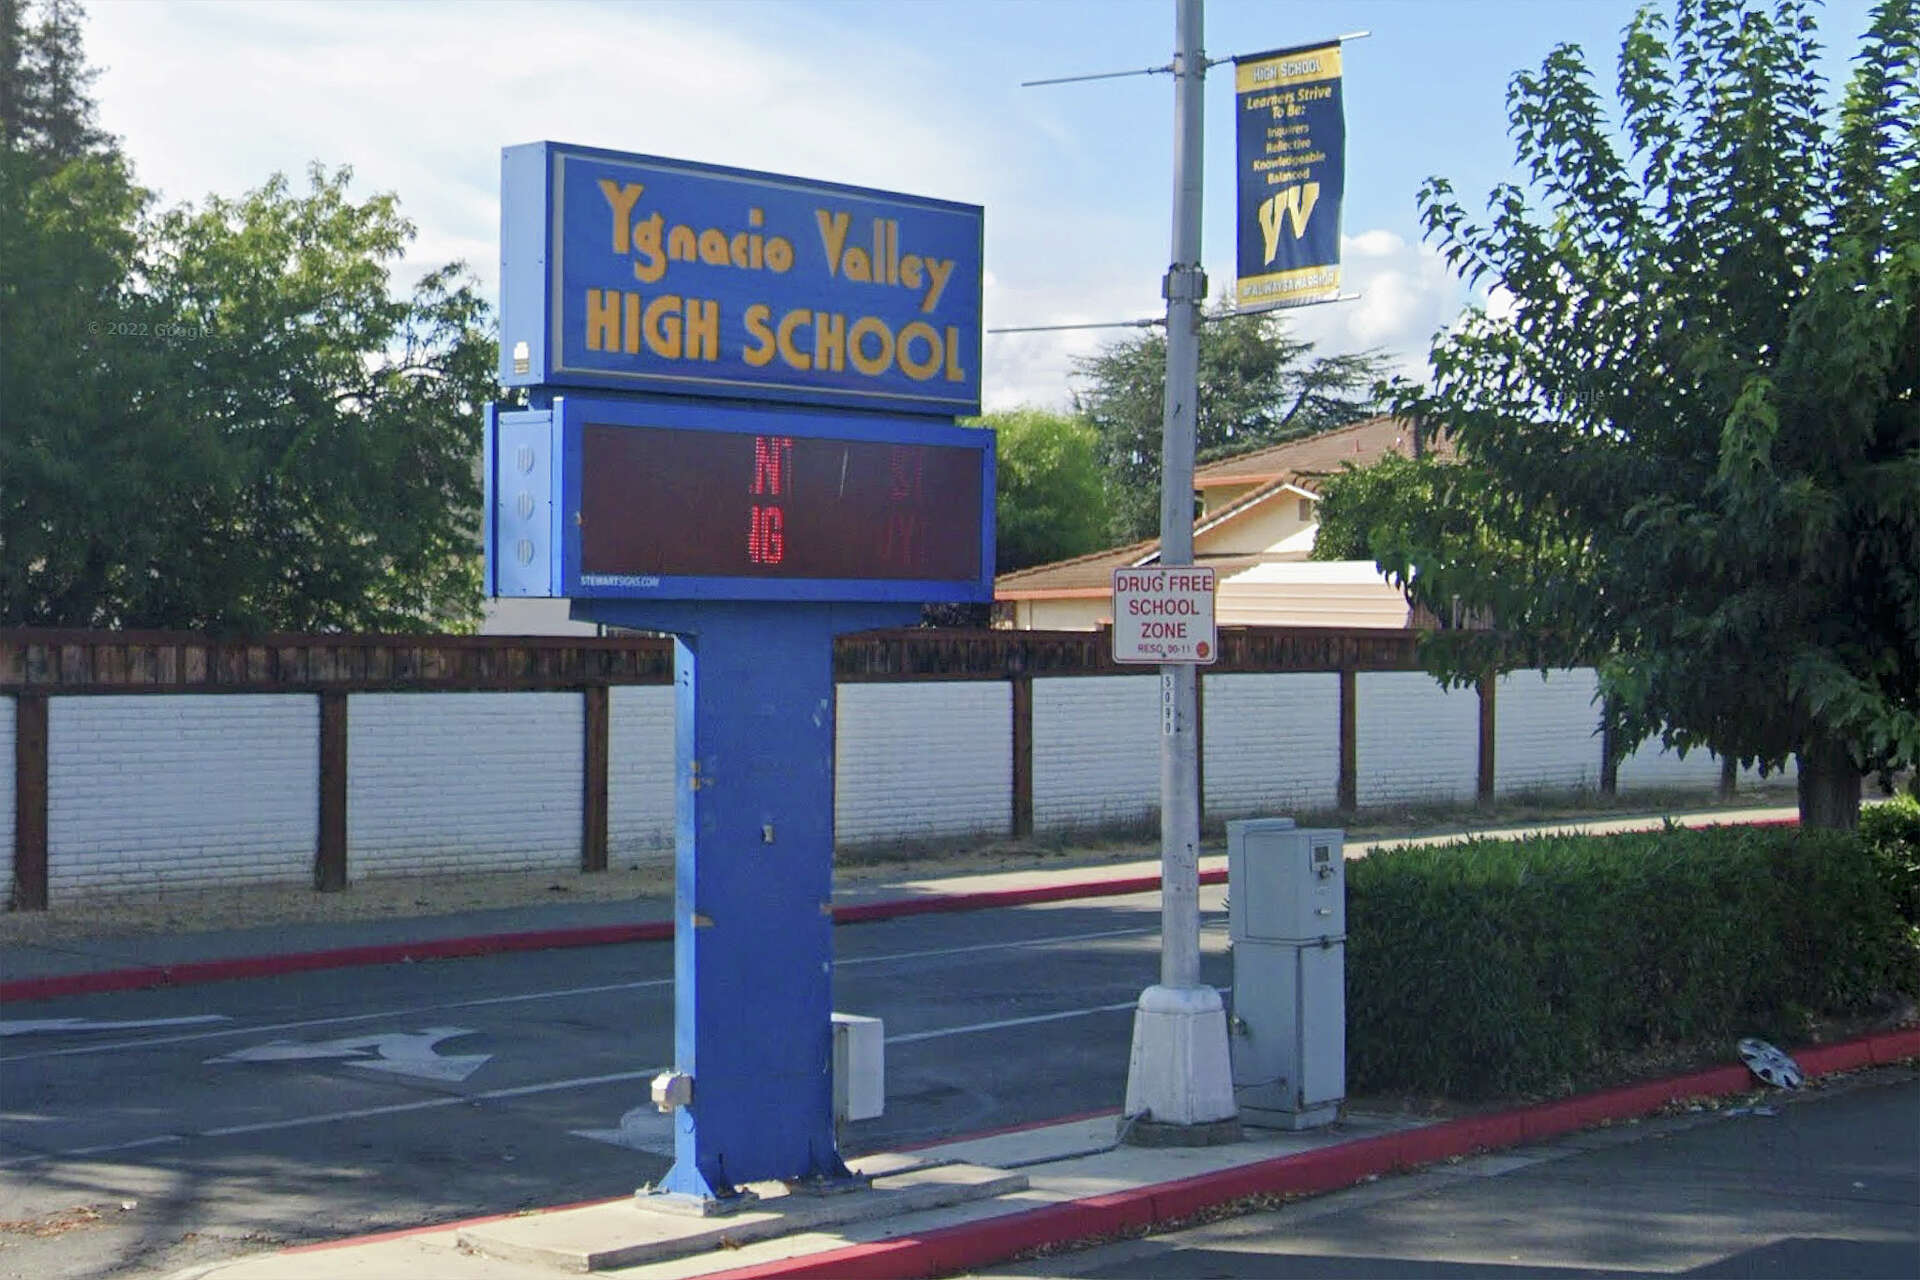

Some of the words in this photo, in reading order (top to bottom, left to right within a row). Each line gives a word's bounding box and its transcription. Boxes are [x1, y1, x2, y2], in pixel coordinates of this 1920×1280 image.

[1280, 59, 1321, 78] SCHOOL
[1246, 94, 1294, 110] Learners
[1297, 86, 1332, 102] Strive
[1272, 105, 1284, 119] To
[597, 179, 794, 284] Ygnacio
[815, 208, 955, 314] Valley
[585, 289, 719, 363] HIGH
[743, 304, 966, 382] SCHOOL
[1117, 576, 1163, 592] DRUG
[1169, 575, 1213, 592] FREE
[1129, 599, 1200, 616] SCHOOL
[1141, 622, 1187, 639] ZONE
